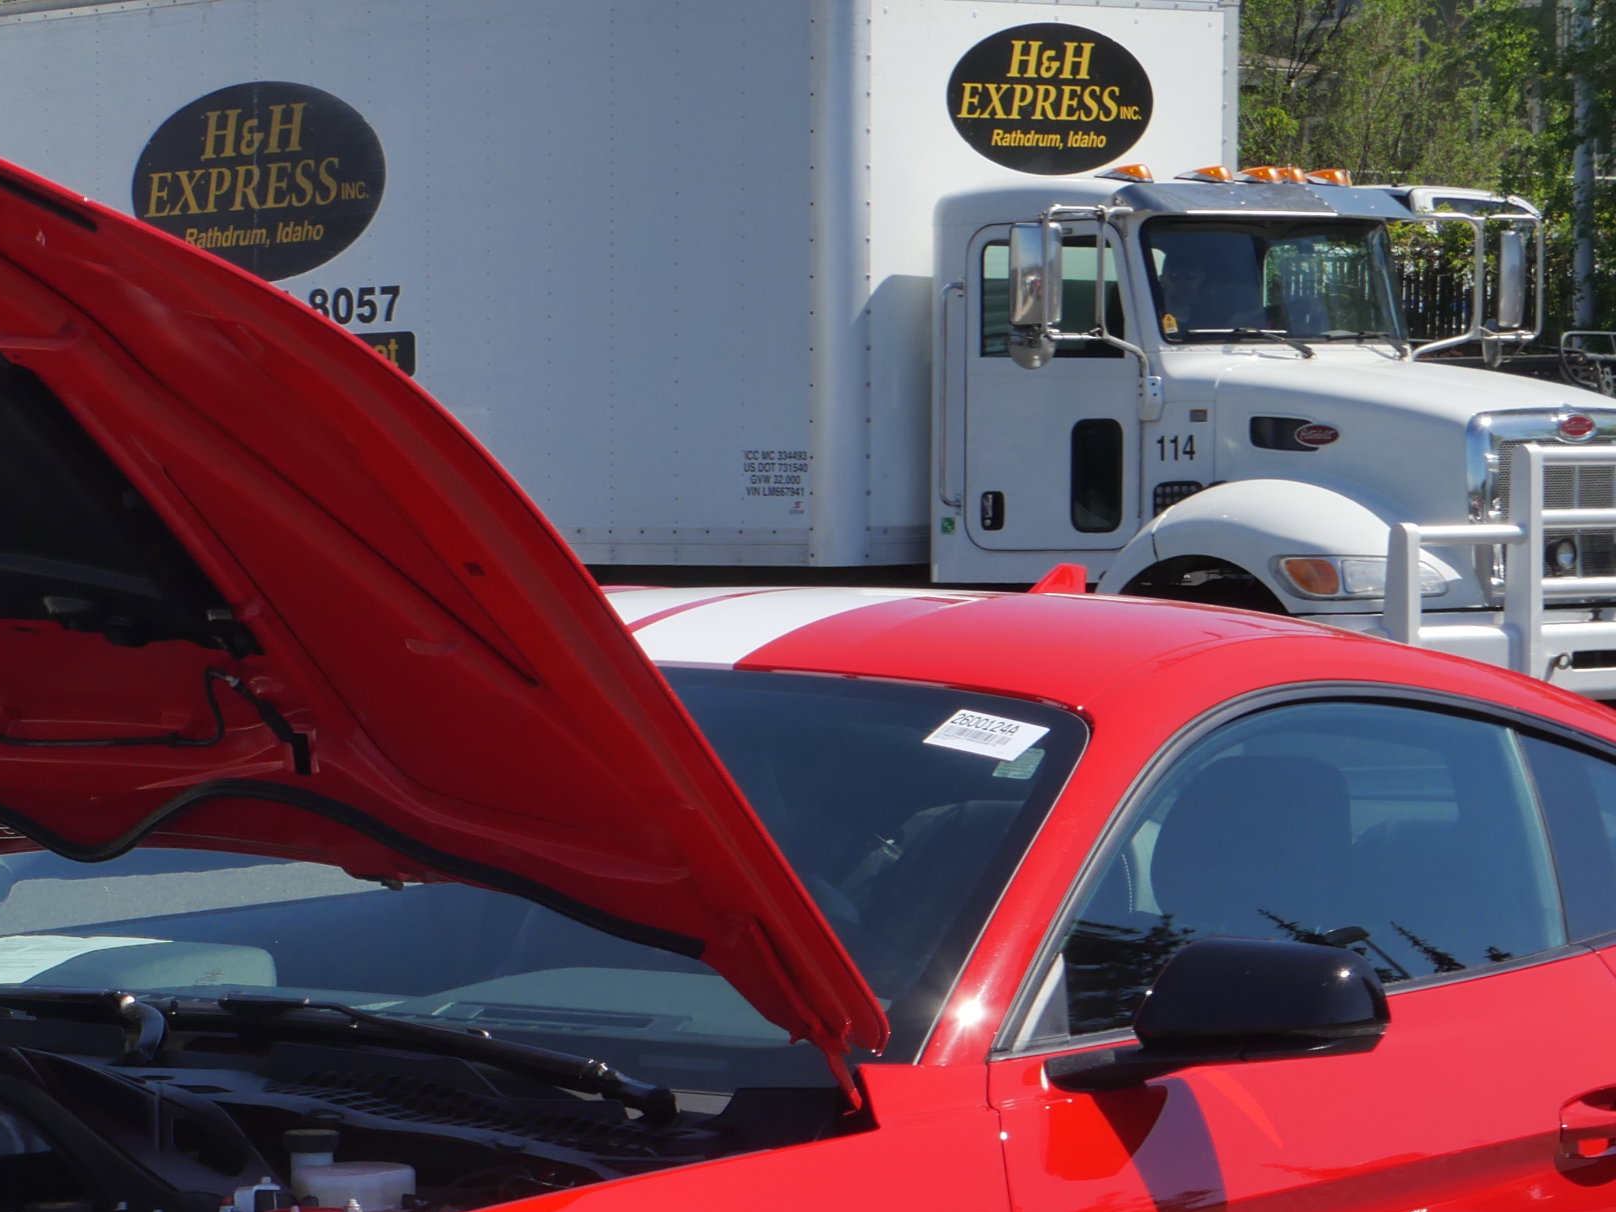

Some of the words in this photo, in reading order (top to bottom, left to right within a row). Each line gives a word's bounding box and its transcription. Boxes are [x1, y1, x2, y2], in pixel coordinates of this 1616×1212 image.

[1005, 39, 1095, 80] H&H
[956, 82, 1120, 122] EXPRESS
[1120, 105, 1142, 120] INC.
[199, 102, 307, 160] H&H
[991, 129, 1064, 150] Rathdrum,
[1067, 130, 1107, 149] Idaho
[143, 157, 340, 218] EXPRESS
[340, 180, 370, 200] INC.
[184, 222, 270, 249] Rathdrum,
[276, 219, 324, 244] Idaho
[308, 285, 401, 325] 8057
[743, 462, 756, 473] US
[758, 462, 776, 473] DOT
[1156, 434, 1196, 462] 114
